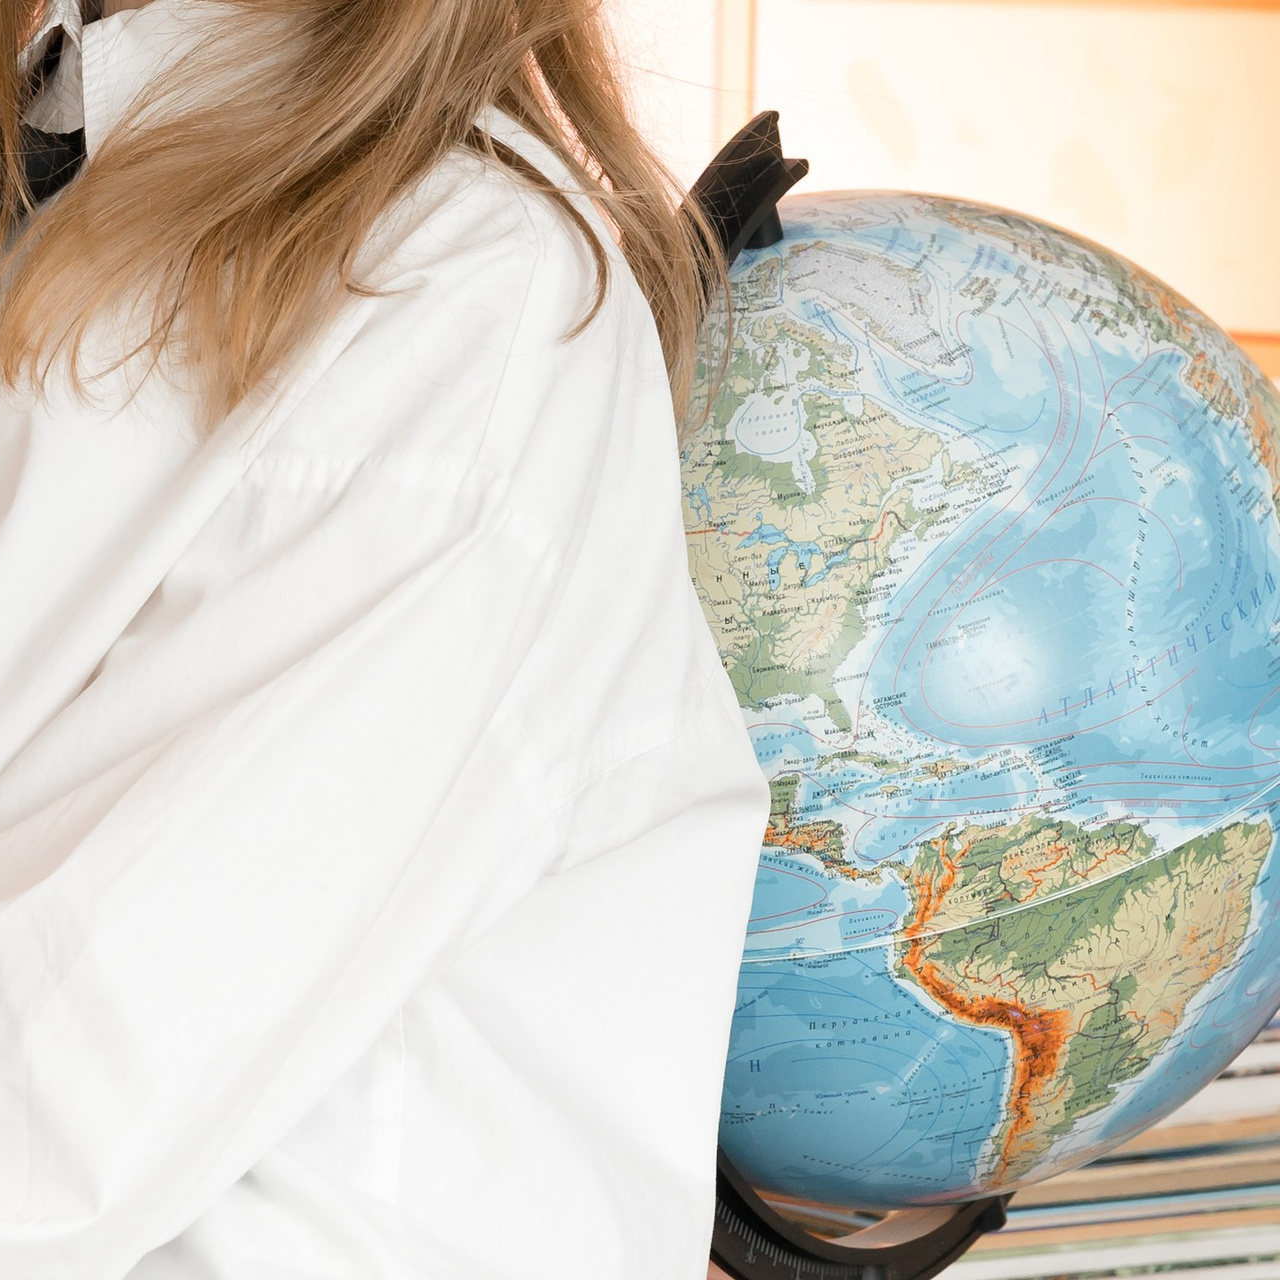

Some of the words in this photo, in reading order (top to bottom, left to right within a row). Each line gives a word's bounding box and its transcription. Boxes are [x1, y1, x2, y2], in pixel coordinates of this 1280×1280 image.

[1037, 571, 1276, 726] АТЛАНТИЧЕСКИЙ
[872, 691, 907, 705] БАГАМСКИЕ
[875, 700, 903, 711] ОСТРОВА
[1153, 715, 1209, 749] хребет
[1003, 841, 1052, 861] ВЕНЕСУЭЛА
[948, 887, 994, 904] КОЛУМБИЯ
[809, 1009, 912, 1030] Перуанская
[815, 1030, 911, 1049] котловина
